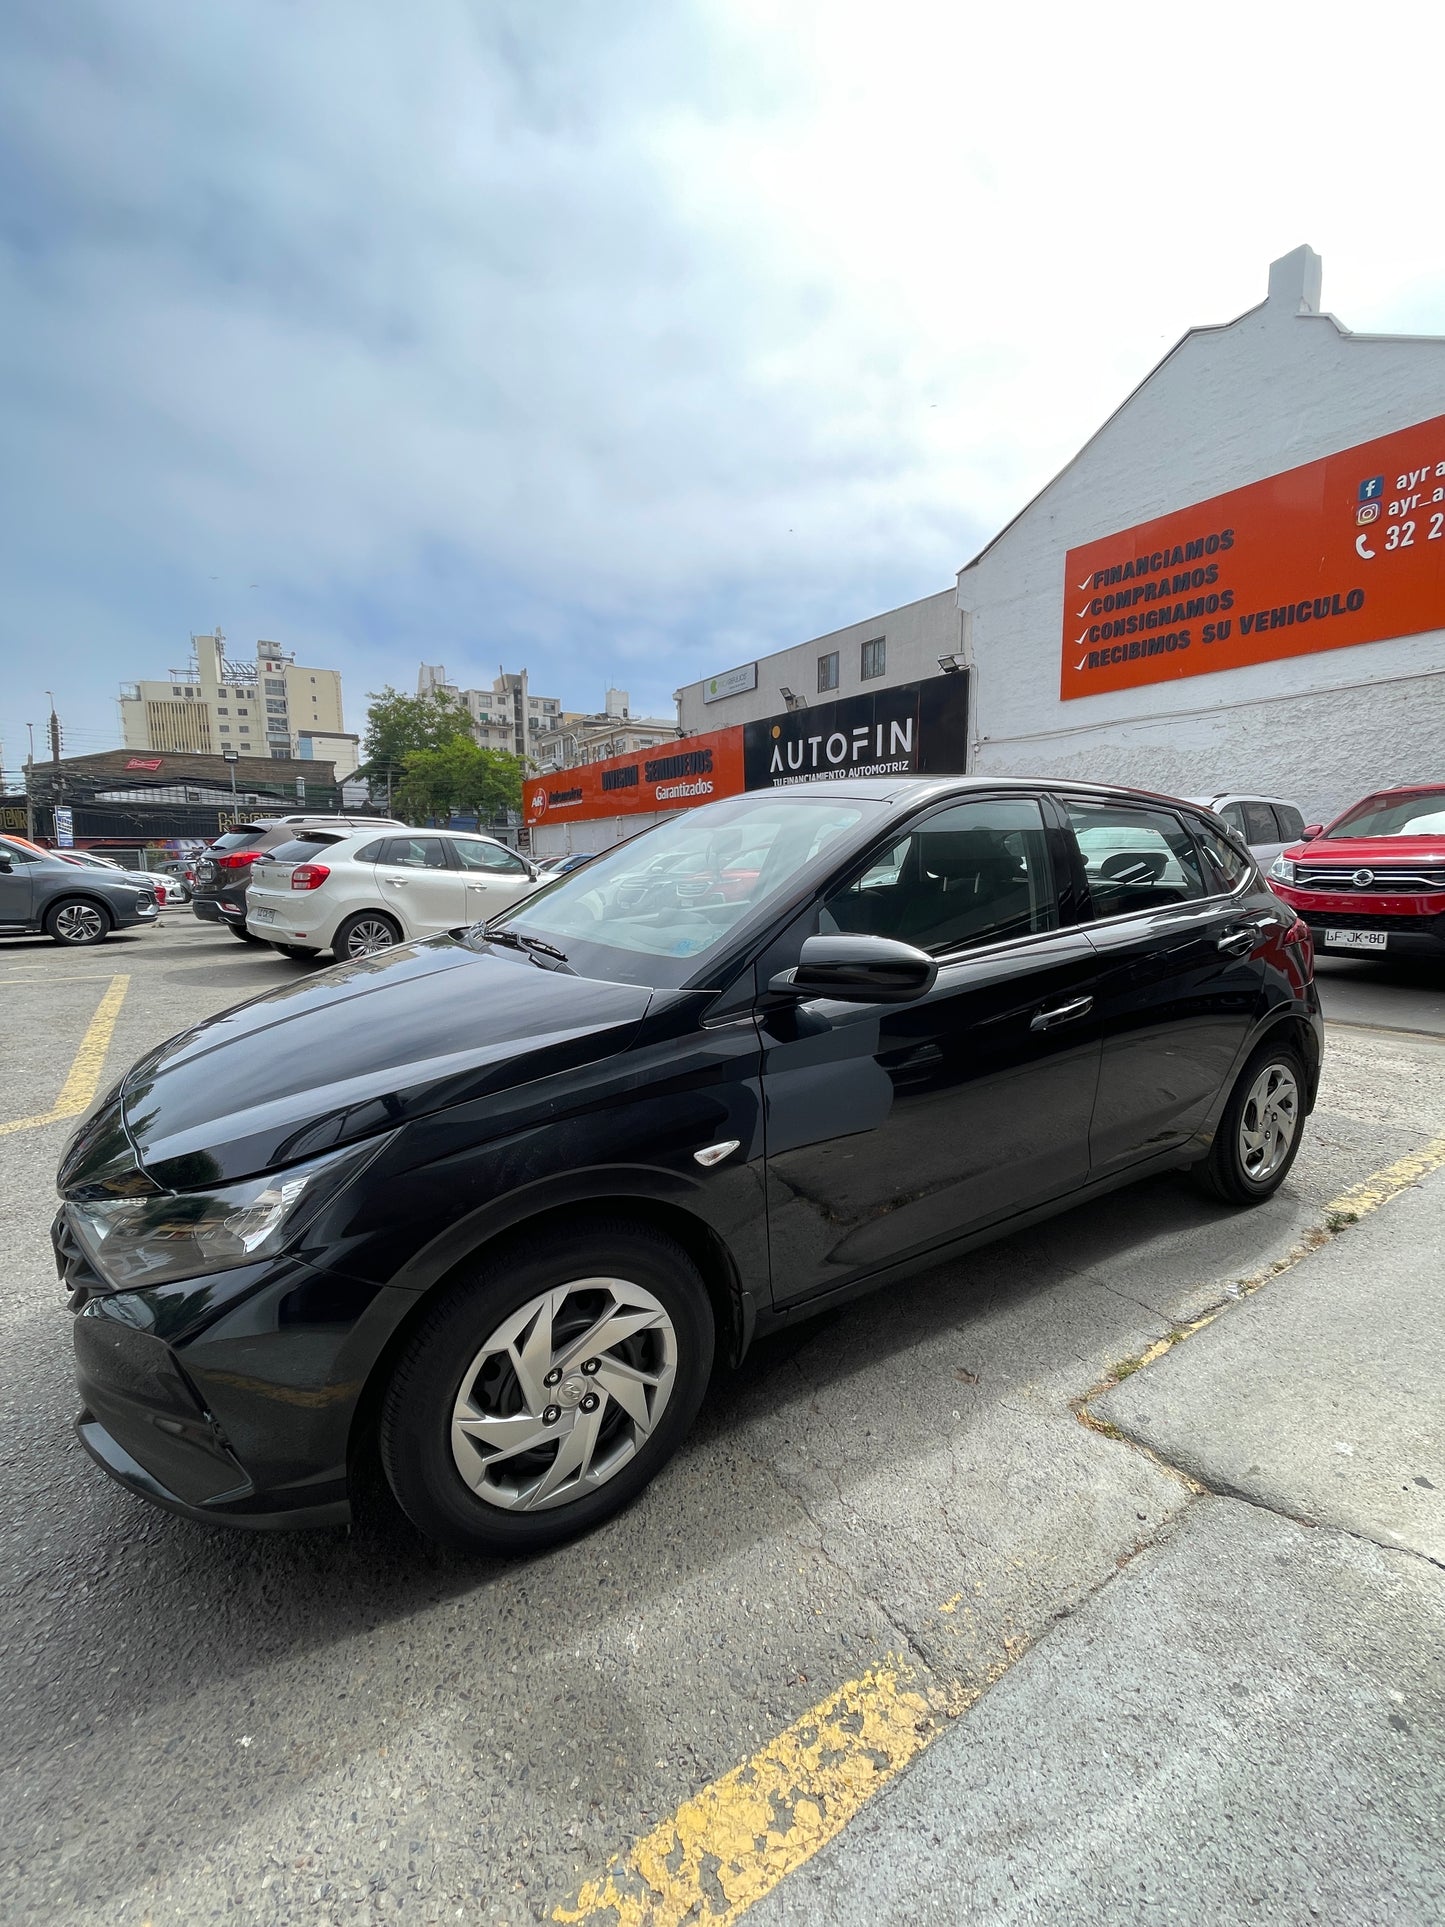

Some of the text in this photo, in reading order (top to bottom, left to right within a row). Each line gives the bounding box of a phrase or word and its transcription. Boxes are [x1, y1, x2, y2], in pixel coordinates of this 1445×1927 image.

[1396, 466, 1431, 491] ayr
[1385, 512, 1445, 550] 32 2
[1092, 529, 1234, 590] FINANCIAMOS
[1090, 563, 1219, 617] COMPRAMOS
[1087, 588, 1365, 669] RECIBIMOS SU VEHICULO
[1088, 588, 1234, 644] CONSIGNAMOS
[644, 749, 713, 782] SEMINUEVOS
[770, 717, 912, 773] AUTOFIN
[655, 778, 714, 801] Garantizados
[783, 768, 846, 786] FINANCIAMIENTO
[848, 760, 909, 779] AUTOMOTRIZ
